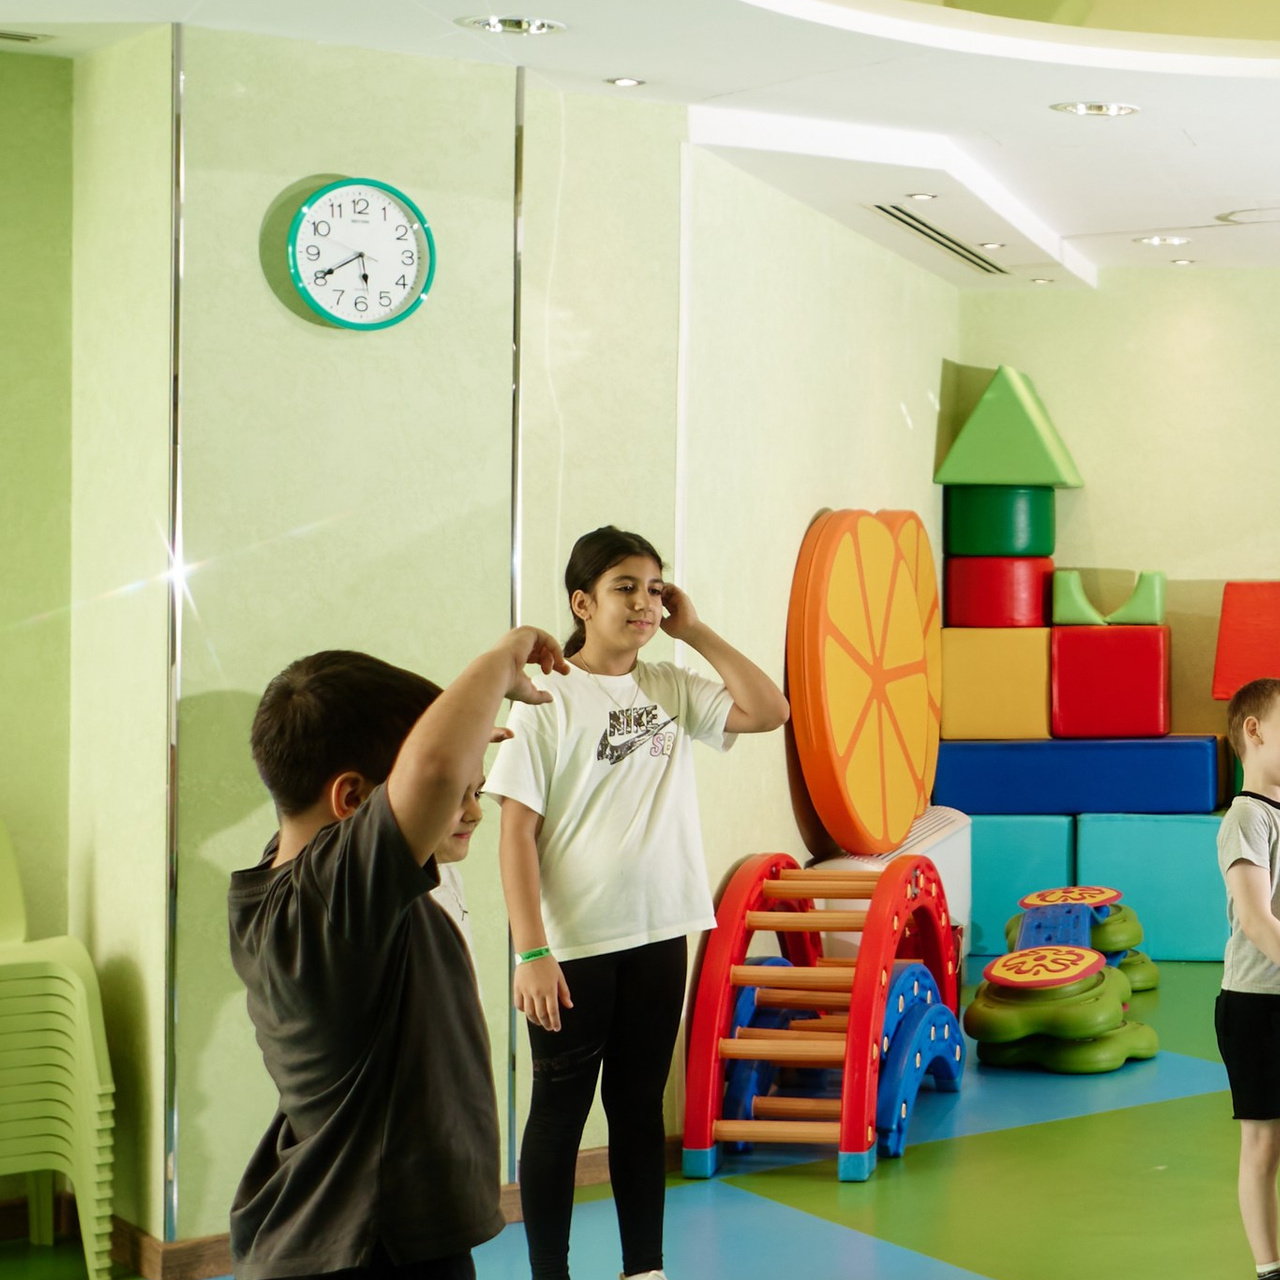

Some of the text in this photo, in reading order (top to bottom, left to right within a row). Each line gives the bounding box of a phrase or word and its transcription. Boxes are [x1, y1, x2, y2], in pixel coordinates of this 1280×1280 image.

[330, 203, 343, 219] 11
[352, 198, 370, 215] 12
[382, 206, 387, 221] 1
[312, 220, 331, 237] 10
[395, 224, 408, 241] 2
[306, 245, 320, 261] 9
[401, 250, 415, 266] 3
[313, 270, 327, 286] 8
[395, 274, 408, 290] 4
[332, 289, 345, 306] 7
[354, 296, 368, 312] 6
[379, 291, 392, 307] 5
[608, 704, 659, 737] NIKE
[650, 732, 675, 758] SB
